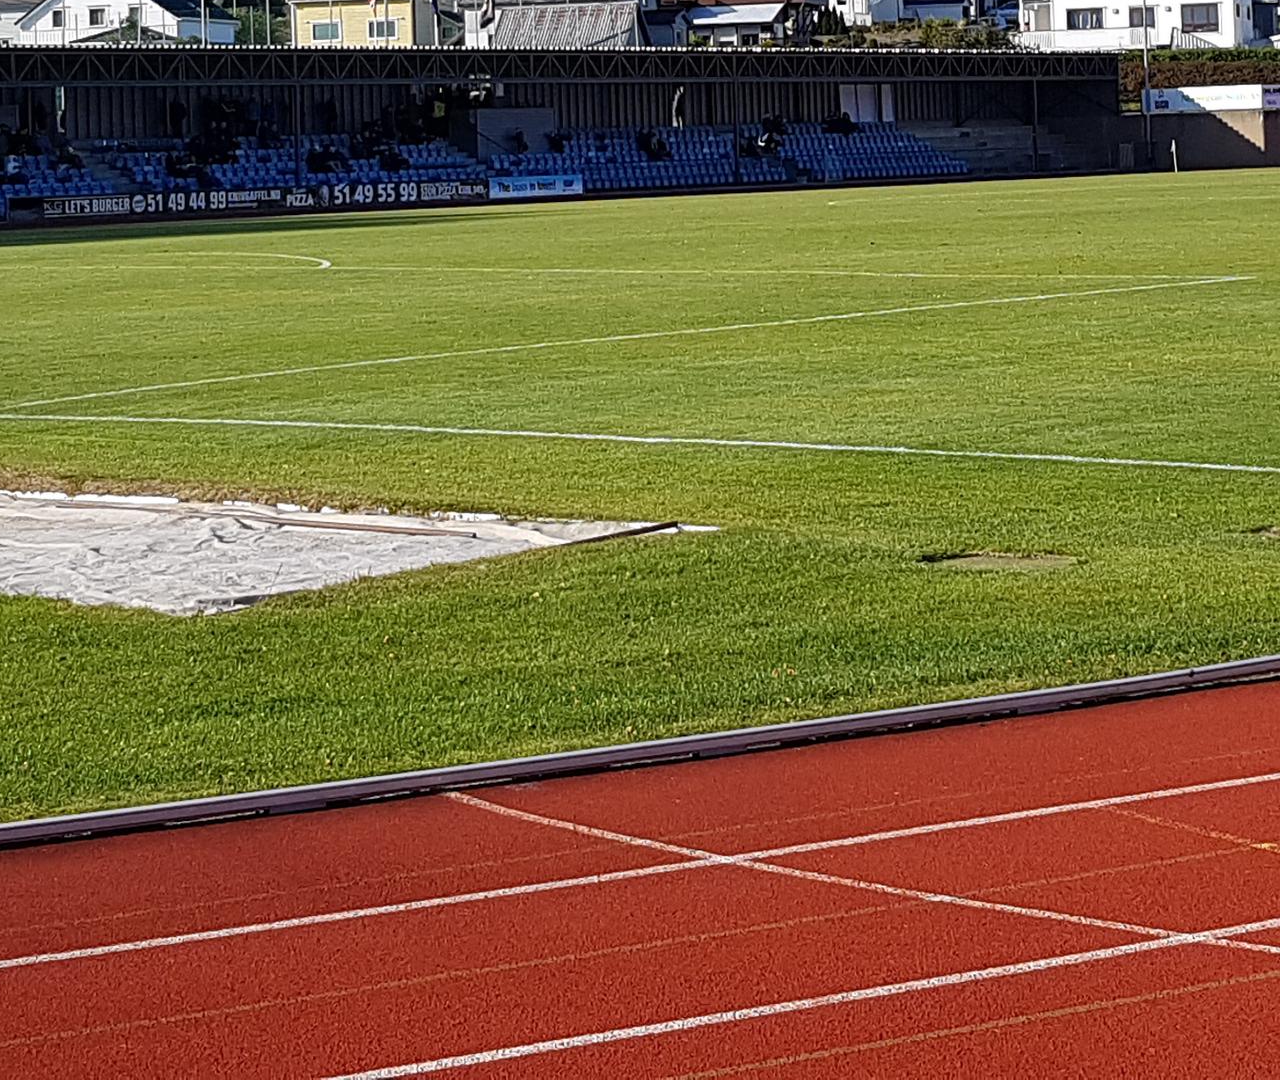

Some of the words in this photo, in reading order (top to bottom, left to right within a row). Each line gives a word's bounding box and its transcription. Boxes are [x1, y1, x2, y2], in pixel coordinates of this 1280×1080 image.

[65, 199, 90, 214] LET'S
[147, 193, 163, 212] 51
[168, 192, 186, 211] 49
[189, 191, 206, 210] 44
[209, 190, 227, 209] 99
[286, 193, 314, 208] PIZZA
[334, 184, 350, 205] 51
[354, 183, 374, 204] 49
[377, 182, 396, 203] 55
[399, 182, 418, 202] 99
